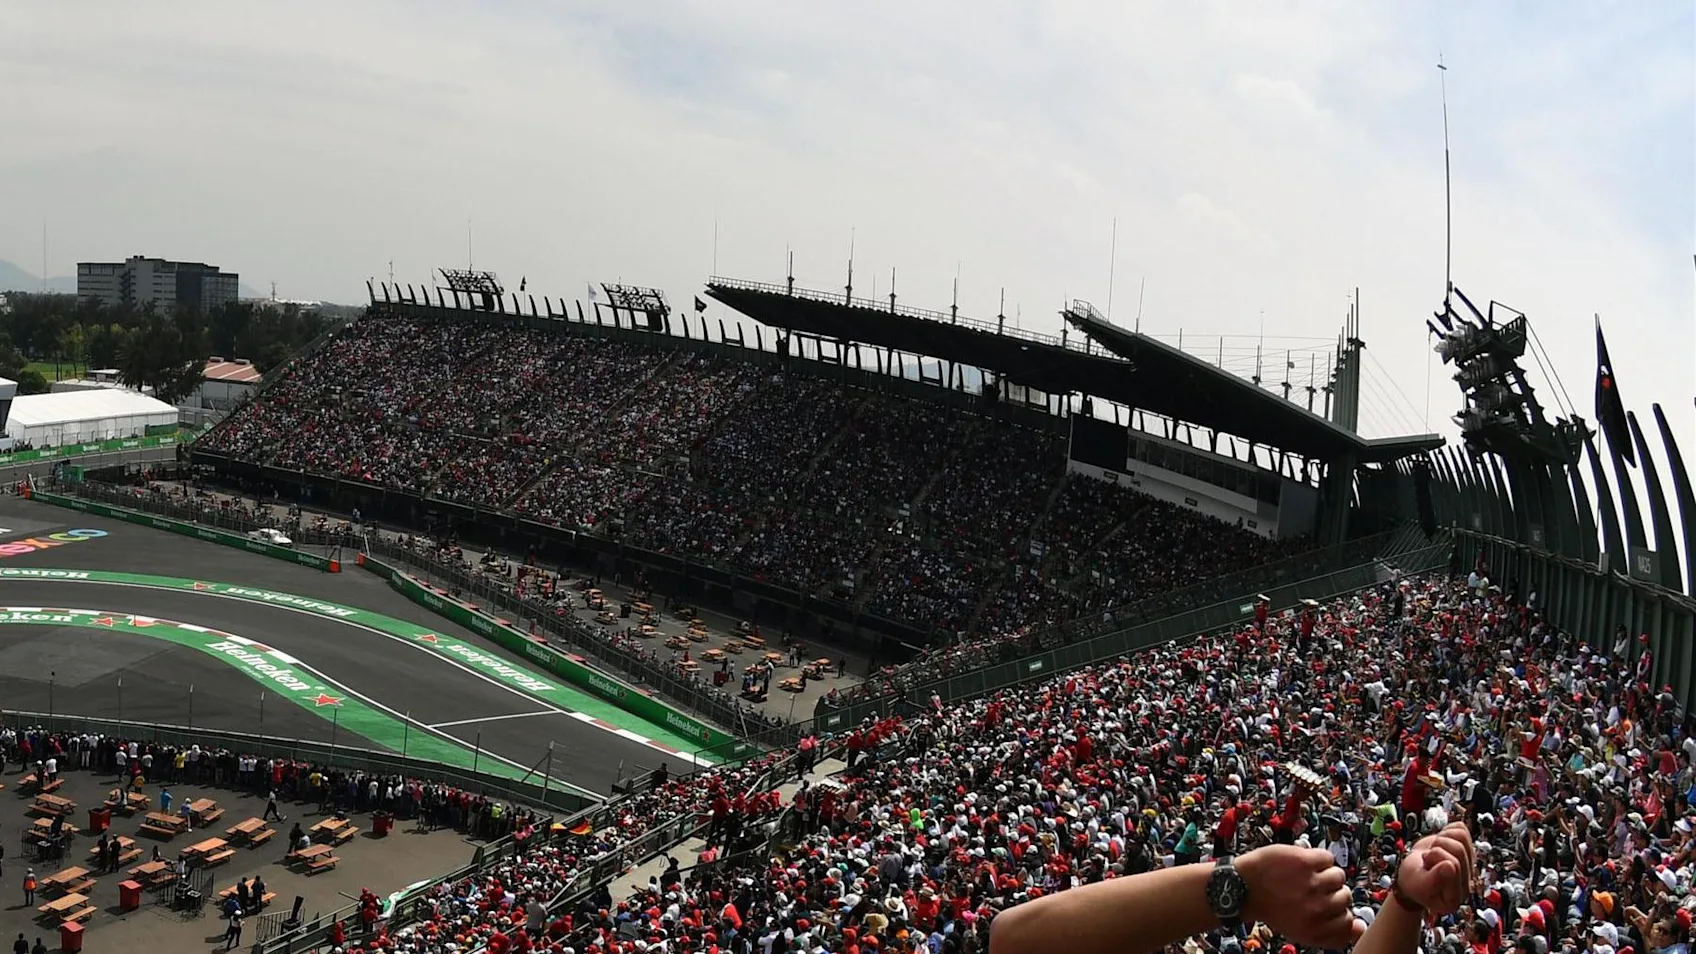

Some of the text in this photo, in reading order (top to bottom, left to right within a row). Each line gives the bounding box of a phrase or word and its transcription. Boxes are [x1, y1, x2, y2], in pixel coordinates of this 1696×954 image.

[225, 588, 358, 617] Heineken
[205, 640, 312, 691] Heineken
[447, 644, 557, 692] Heineken
[589, 674, 619, 698] Heineken
[666, 712, 701, 737] Heineken
